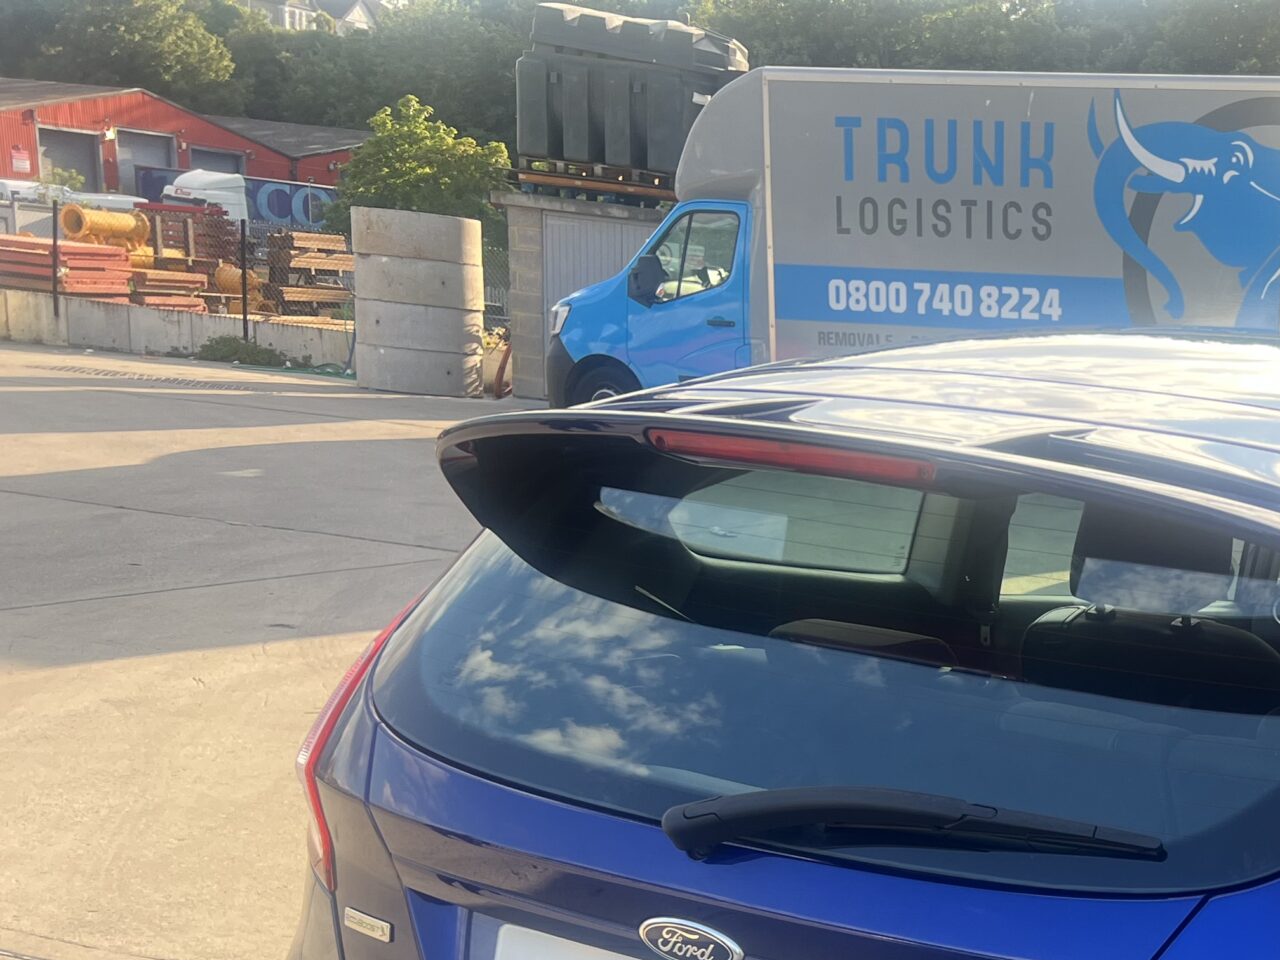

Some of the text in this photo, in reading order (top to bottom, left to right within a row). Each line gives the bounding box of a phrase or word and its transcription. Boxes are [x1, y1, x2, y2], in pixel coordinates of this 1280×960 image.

[835, 116, 1055, 189] TRUNK
[836, 196, 1053, 241] LOGISTICS
[828, 279, 1062, 321] 0800 740 8224
